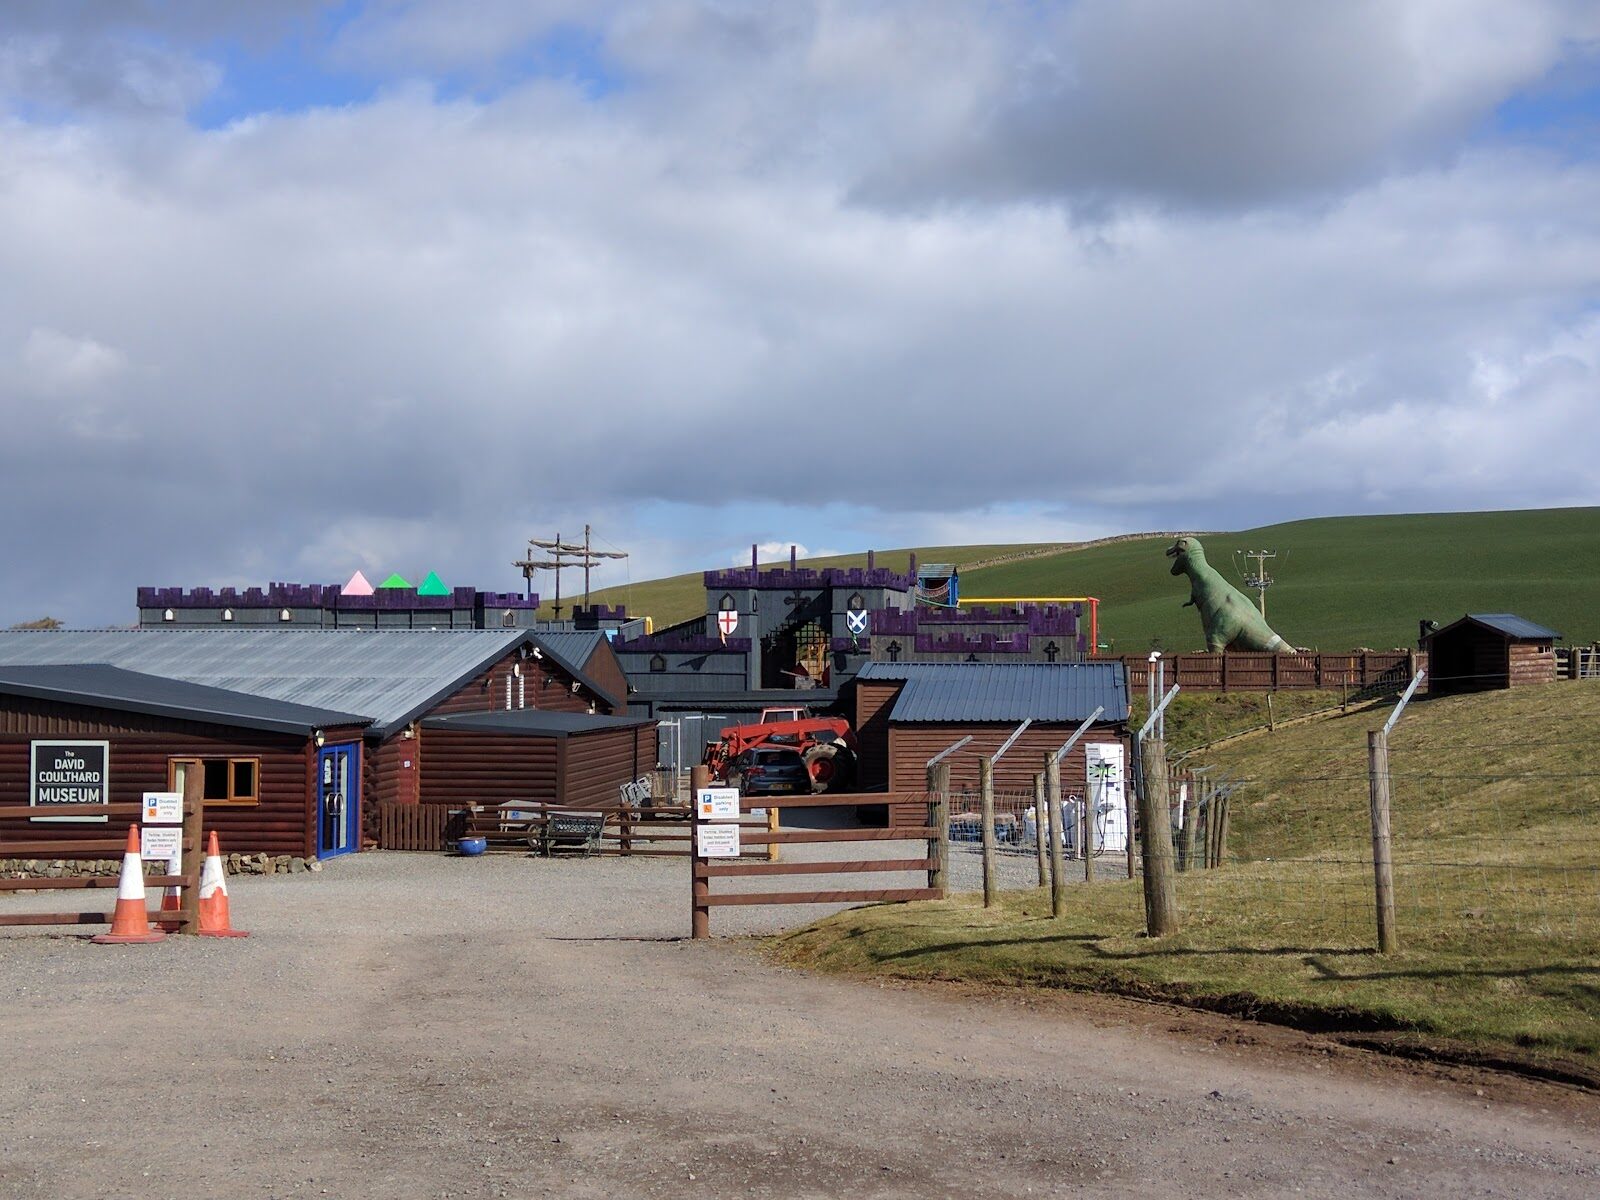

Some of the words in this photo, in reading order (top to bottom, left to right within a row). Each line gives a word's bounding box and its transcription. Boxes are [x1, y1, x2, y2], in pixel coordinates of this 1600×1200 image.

[54, 758, 85, 770] DAVID
[39, 771, 100, 782] COULTHARD
[39, 788, 100, 802] MUSEUM
